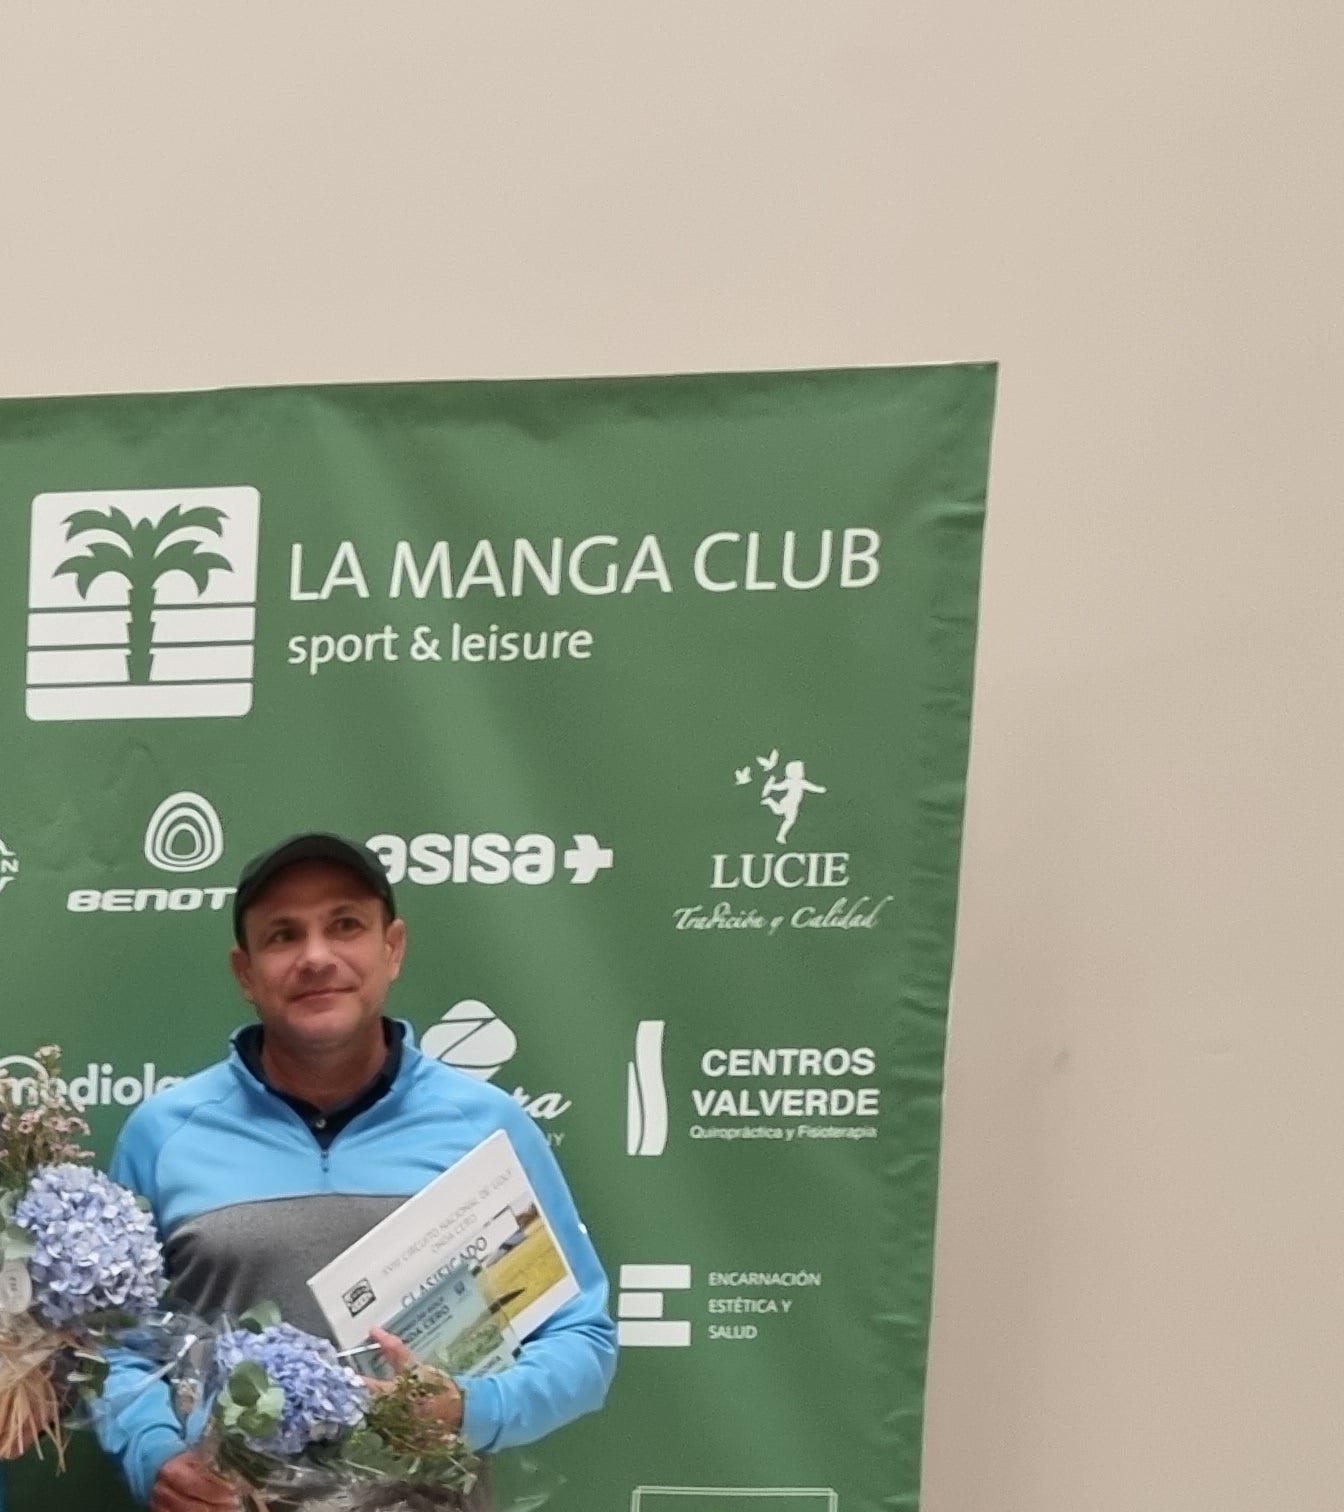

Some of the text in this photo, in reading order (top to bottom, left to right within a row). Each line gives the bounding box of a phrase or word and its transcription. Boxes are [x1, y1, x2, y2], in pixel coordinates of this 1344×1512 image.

[288, 526, 882, 601] LA MANGA CLUB
[287, 622, 595, 675] sport & leisure
[710, 852, 850, 889] LUCIE
[66, 886, 238, 912] BENOT
[790, 896, 895, 931] Calidad
[701, 1047, 877, 1077] CENTROS
[691, 1088, 881, 1117] VALVERDE
[708, 1269, 822, 1287] ENCARNACIÓN
[708, 1296, 793, 1314] ESTÉTICA Y
[708, 1325, 758, 1340] SALUD
